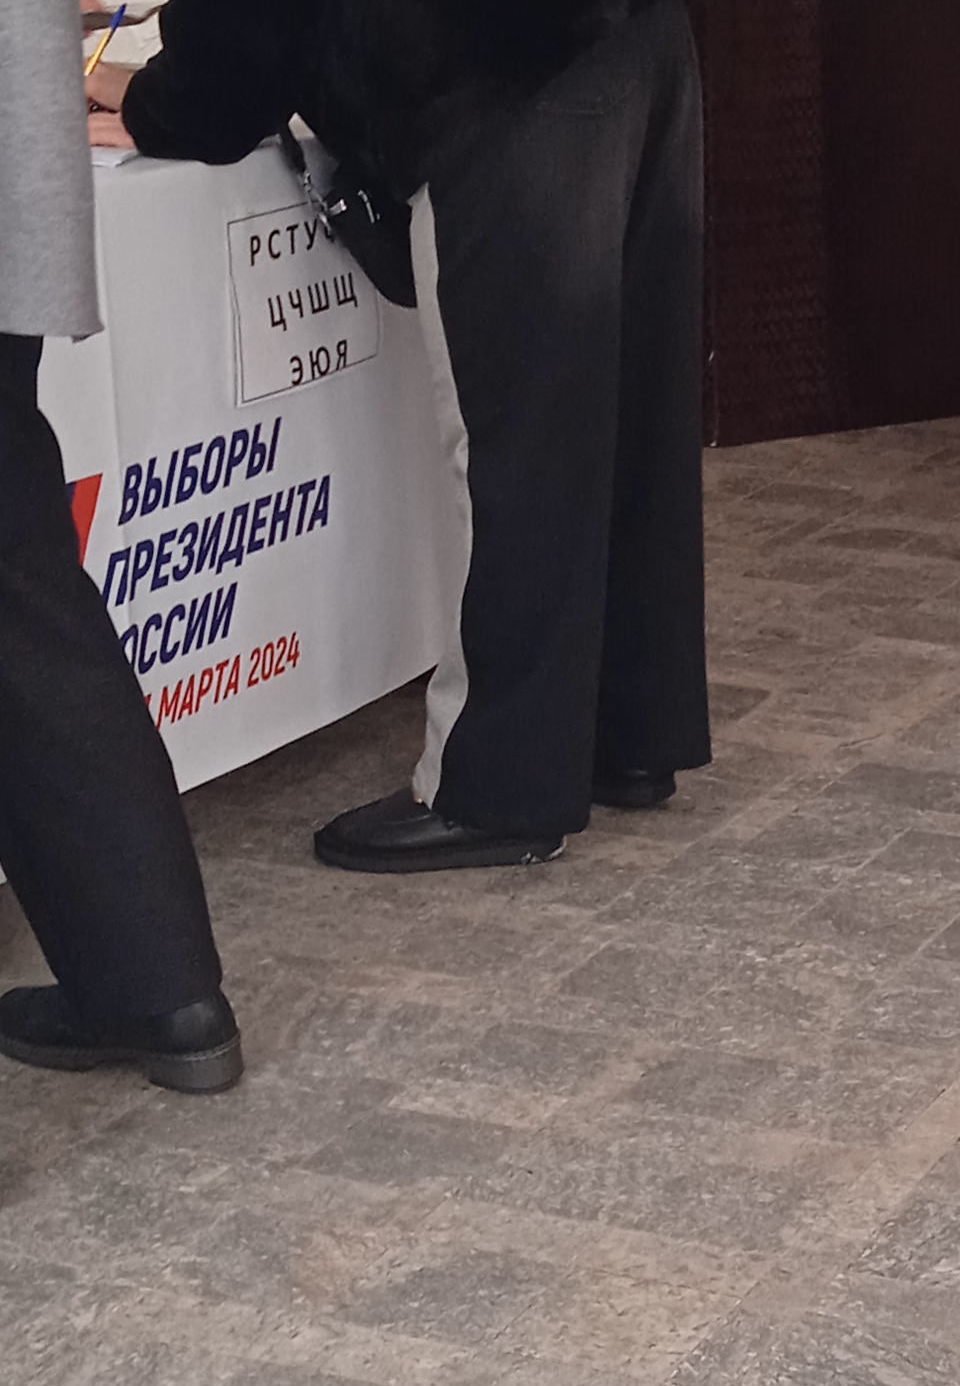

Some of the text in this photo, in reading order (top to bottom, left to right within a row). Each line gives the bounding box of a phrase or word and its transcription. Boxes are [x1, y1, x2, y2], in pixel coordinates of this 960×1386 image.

[250, 216, 335, 267] РСТУ
[267, 271, 359, 331] ЦЧШЩ
[288, 339, 350, 387] ЭЮЯ
[117, 417, 283, 526] ВЫБОРЫ
[102, 474, 333, 609] ПРЕЗИДЕНТА
[119, 581, 239, 675] ОССИИ
[156, 631, 301, 732] МАРТА 2024
